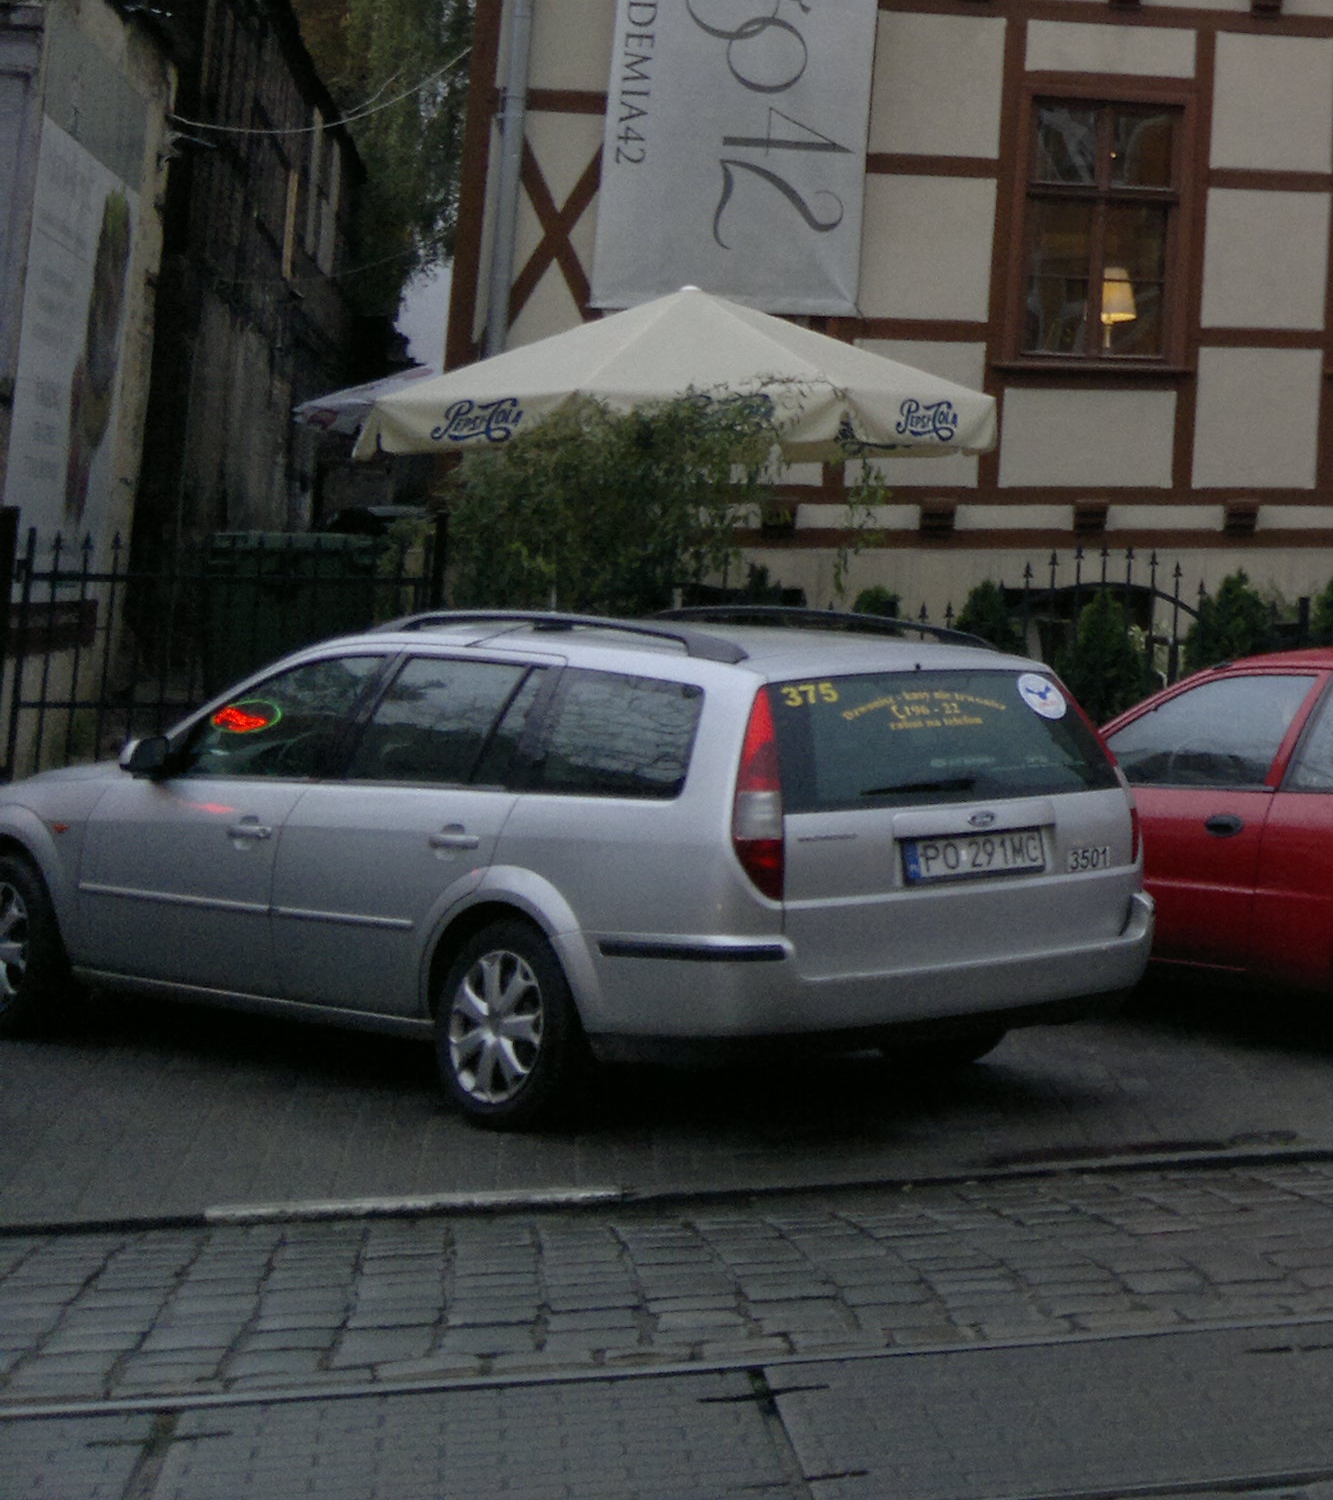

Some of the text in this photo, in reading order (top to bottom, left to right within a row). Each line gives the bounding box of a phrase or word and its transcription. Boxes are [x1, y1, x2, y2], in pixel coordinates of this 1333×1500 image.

[781, 682, 840, 707] 375
[923, 834, 1040, 873] PO 291MC
[1070, 846, 1110, 871] 3501
